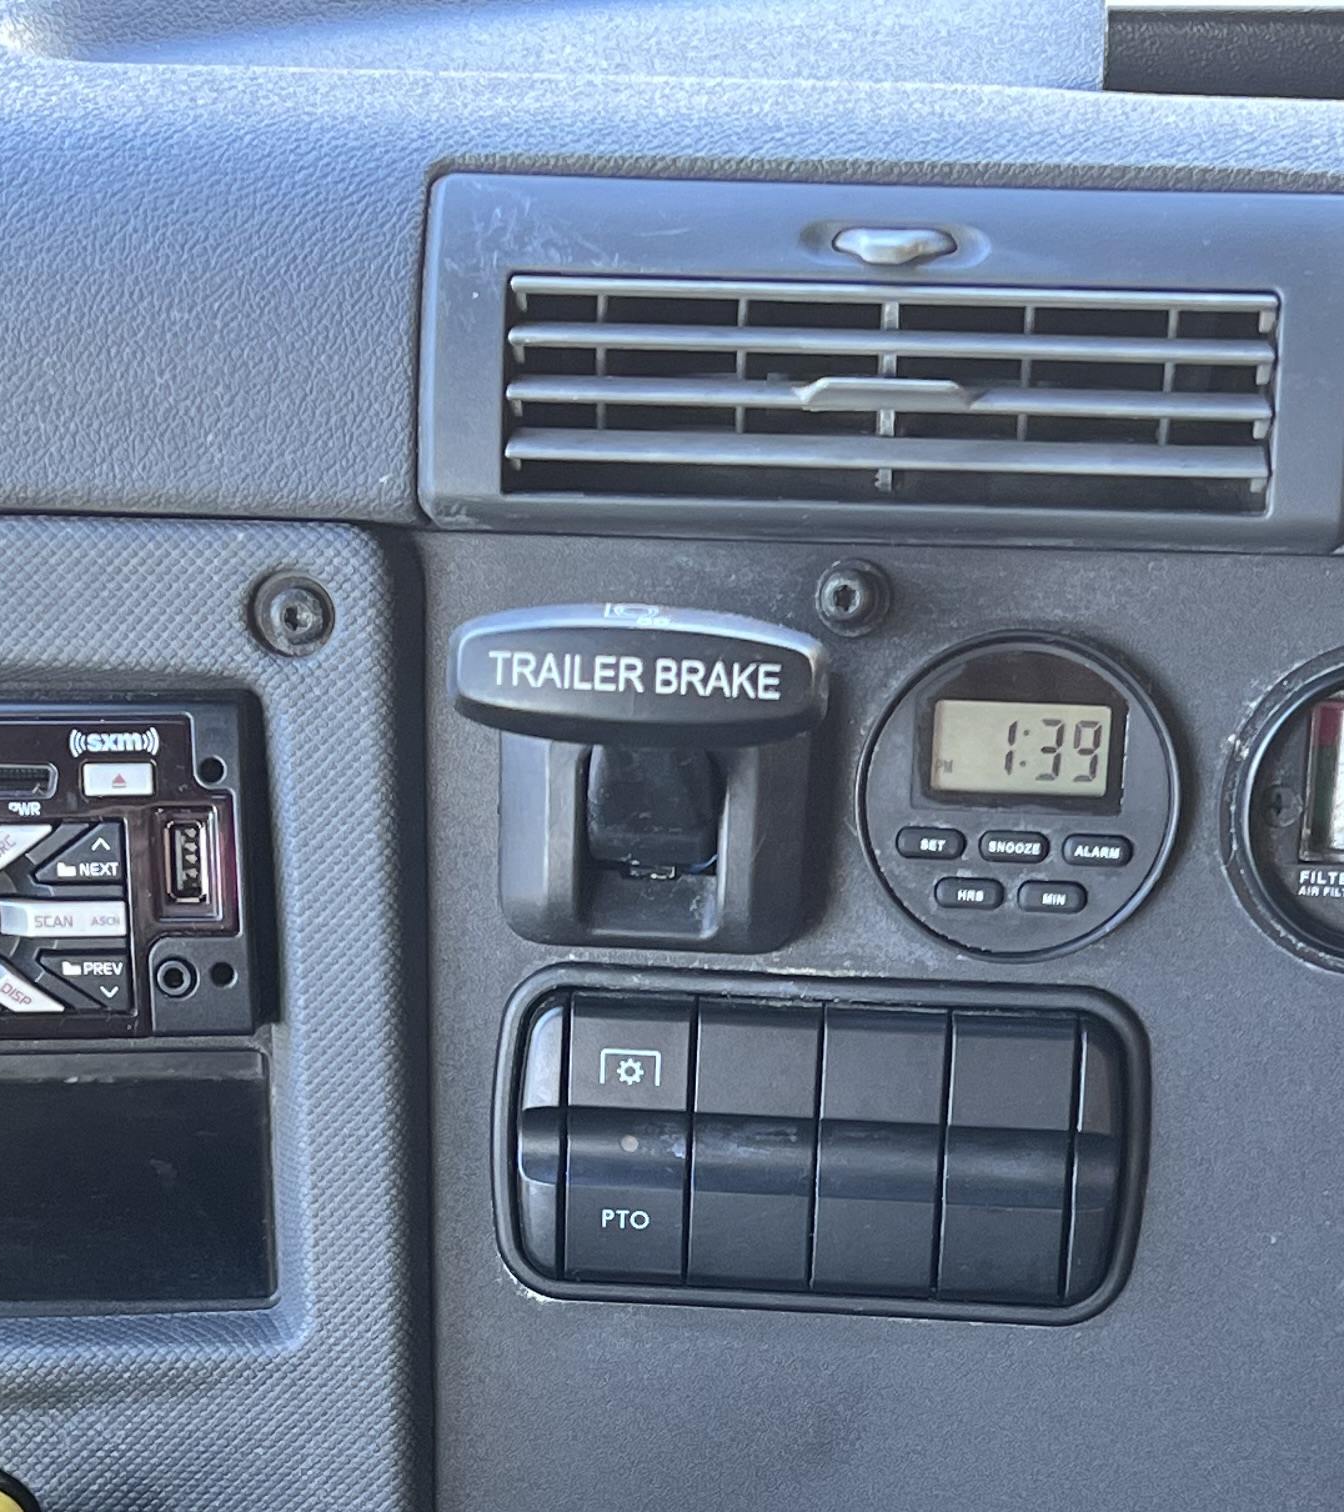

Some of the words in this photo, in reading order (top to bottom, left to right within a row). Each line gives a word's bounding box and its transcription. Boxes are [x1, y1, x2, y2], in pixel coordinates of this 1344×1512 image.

[489, 650, 643, 693] TRAILER
[655, 657, 782, 700] BRAKE
[1005, 719, 1102, 783] 1:39
[920, 838, 946, 851] SET
[988, 840, 1041, 855] SNOOZE
[1074, 845, 1121, 860] ALARM
[79, 862, 119, 876] NEXT
[958, 889, 984, 902] HRS
[1298, 886, 1319, 897] AIR
[1042, 893, 1066, 906] MIN
[34, 915, 74, 928] SCAN
[83, 961, 123, 976] PREV
[0, 982, 32, 1006] DISP
[601, 1209, 650, 1230] PTO
